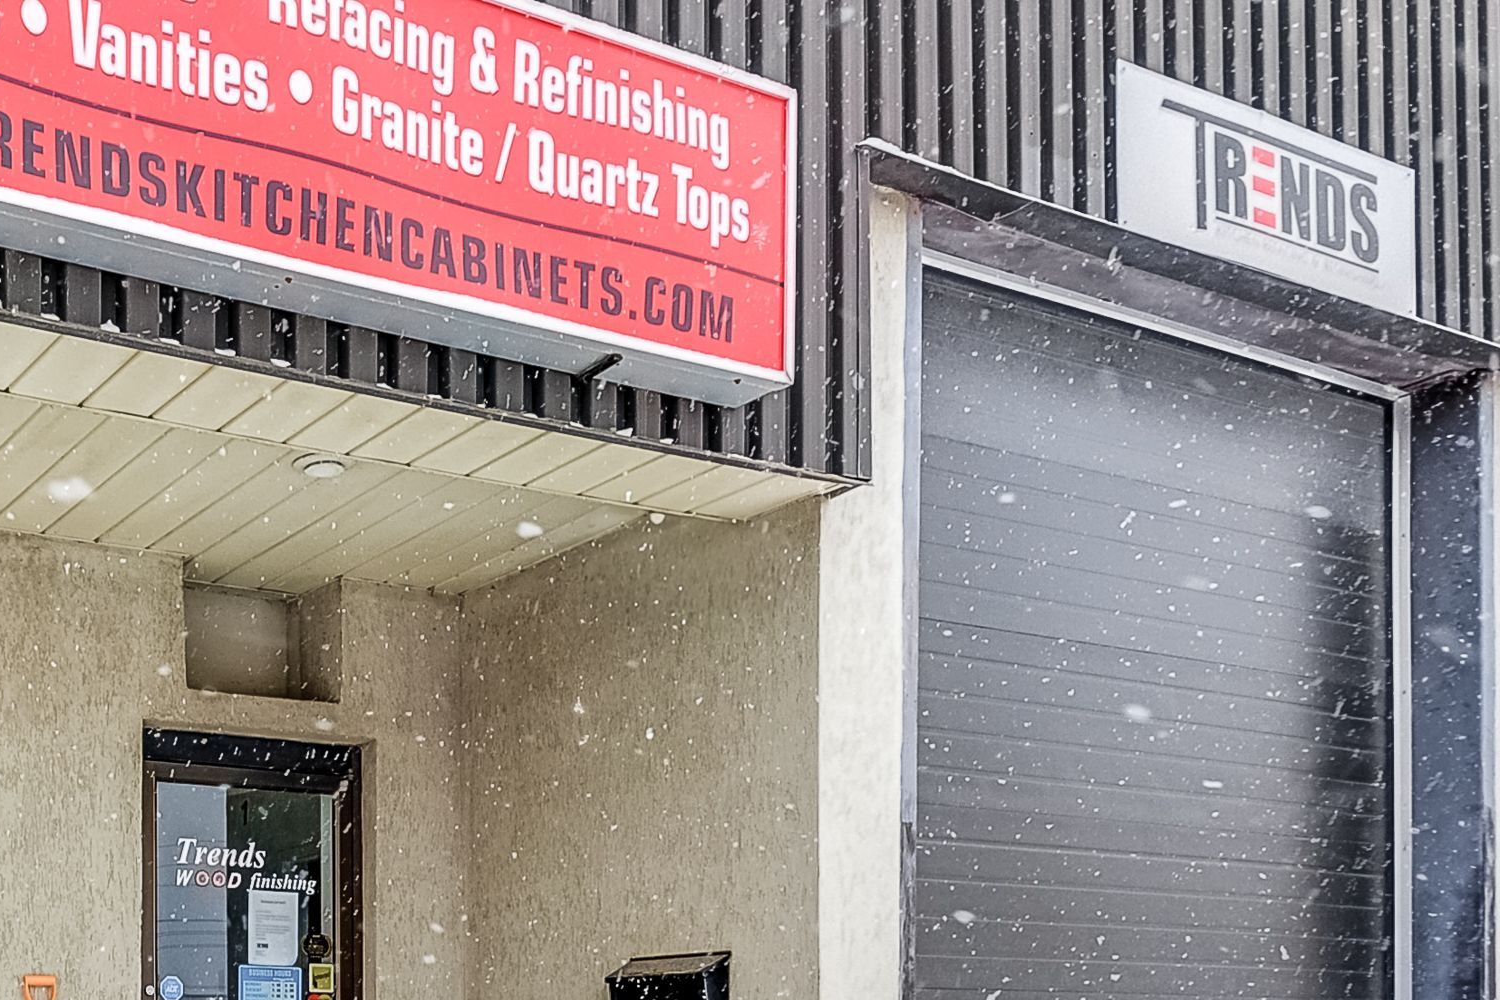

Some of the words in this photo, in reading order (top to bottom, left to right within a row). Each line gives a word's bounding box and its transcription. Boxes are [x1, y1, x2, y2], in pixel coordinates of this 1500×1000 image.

[68, 0, 270, 112] Vanities
[331, 66, 484, 177] Granite
[495, 123, 517, 183] /
[528, 129, 659, 218] Quartz
[671, 163, 750, 248] Tops
[469, 26, 500, 95] &
[513, 39, 730, 171] Refinishing
[1161, 99, 1379, 264] TRENDS
[175, 869, 242, 889] WOOD
[246, 872, 317, 896] finishing
[176, 837, 267, 869] Trends
